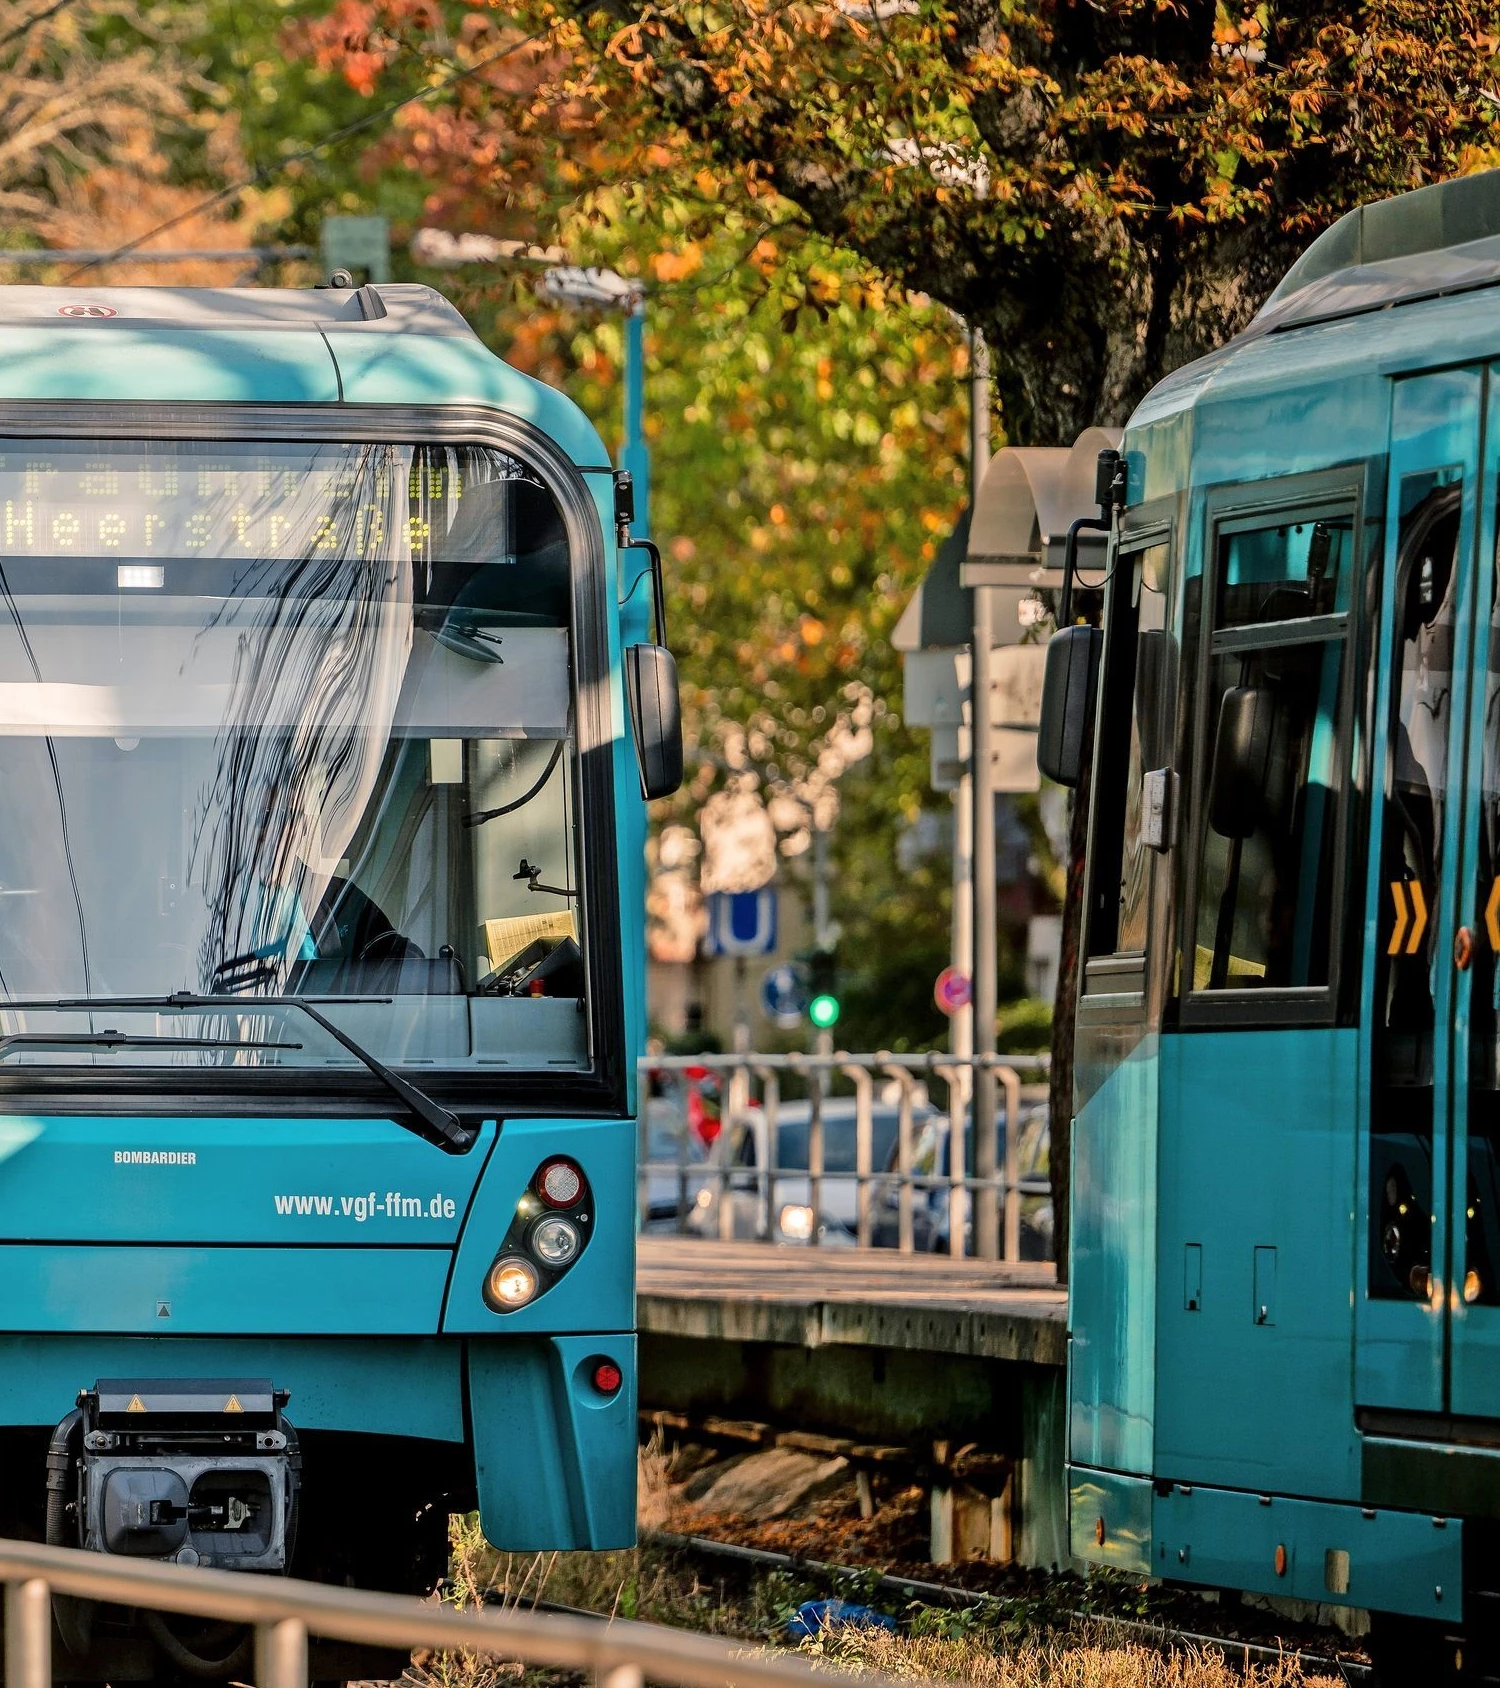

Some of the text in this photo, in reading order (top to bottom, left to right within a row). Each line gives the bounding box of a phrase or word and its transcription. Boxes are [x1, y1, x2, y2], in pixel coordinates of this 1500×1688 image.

[5, 499, 430, 555] Heerstraße
[718, 887, 773, 956] U
[113, 1150, 197, 1165] BOMBARDIER
[274, 1191, 457, 1222] www.vgf-ffm.de
